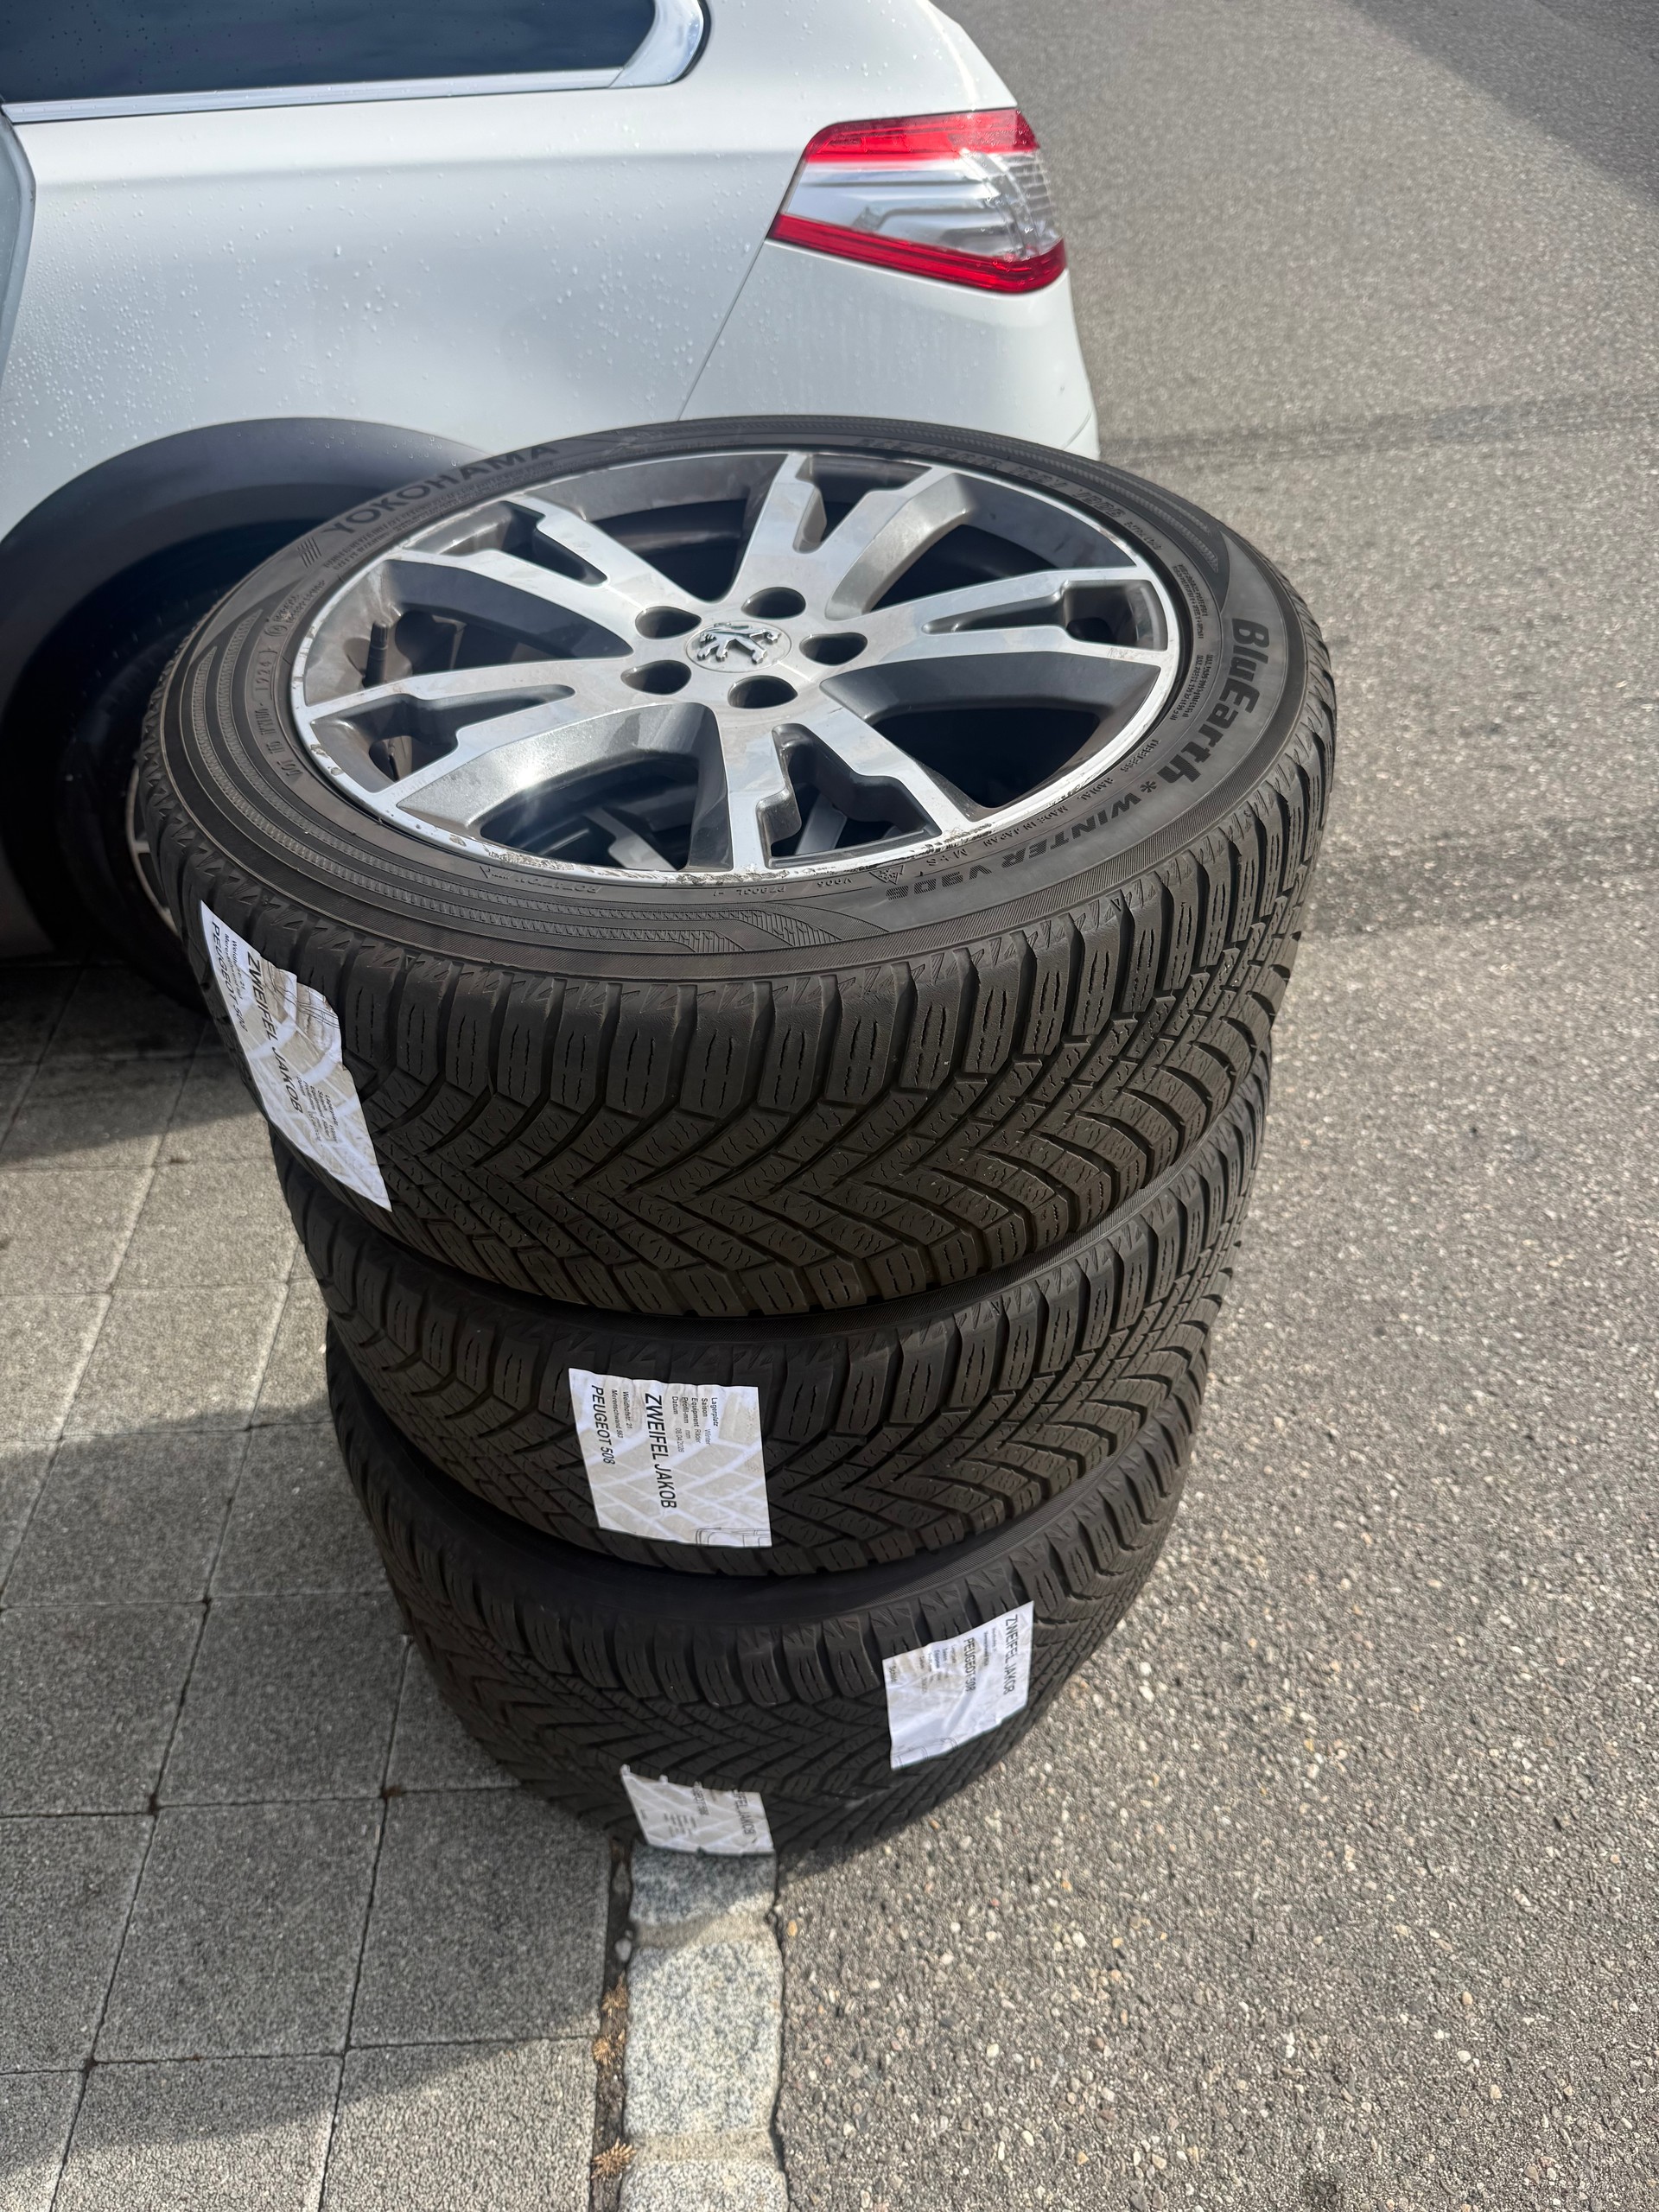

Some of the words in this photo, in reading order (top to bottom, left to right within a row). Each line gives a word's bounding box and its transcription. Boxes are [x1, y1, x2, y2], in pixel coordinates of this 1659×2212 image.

[320, 444, 560, 534] YOKOHAMA
[1156, 618, 1270, 784] BluEarth
[1119, 740, 1160, 772] TUBELESS
[983, 828, 1021, 848] JAPAN
[1001, 791, 1142, 869] WINTER
[1037, 805, 1069, 825] MADE
[885, 865, 993, 900] V906
[212, 921, 238, 1005] PEUGEOT
[232, 1005, 248, 1032] 508
[247, 951, 278, 1041] ZWEIFEL
[271, 1046, 303, 1114] JAKOB
[591, 1384, 612, 1446] PEUGEOT
[645, 1392, 670, 1460] ZWEIFEL
[710, 1397, 719, 1427] Lagerplatz
[601, 1446, 616, 1465] 508
[654, 1463, 677, 1509] JAKOB
[963, 1637, 976, 1677] PEUGEOT
[1005, 1614, 1018, 1663] ZWEIFEL
